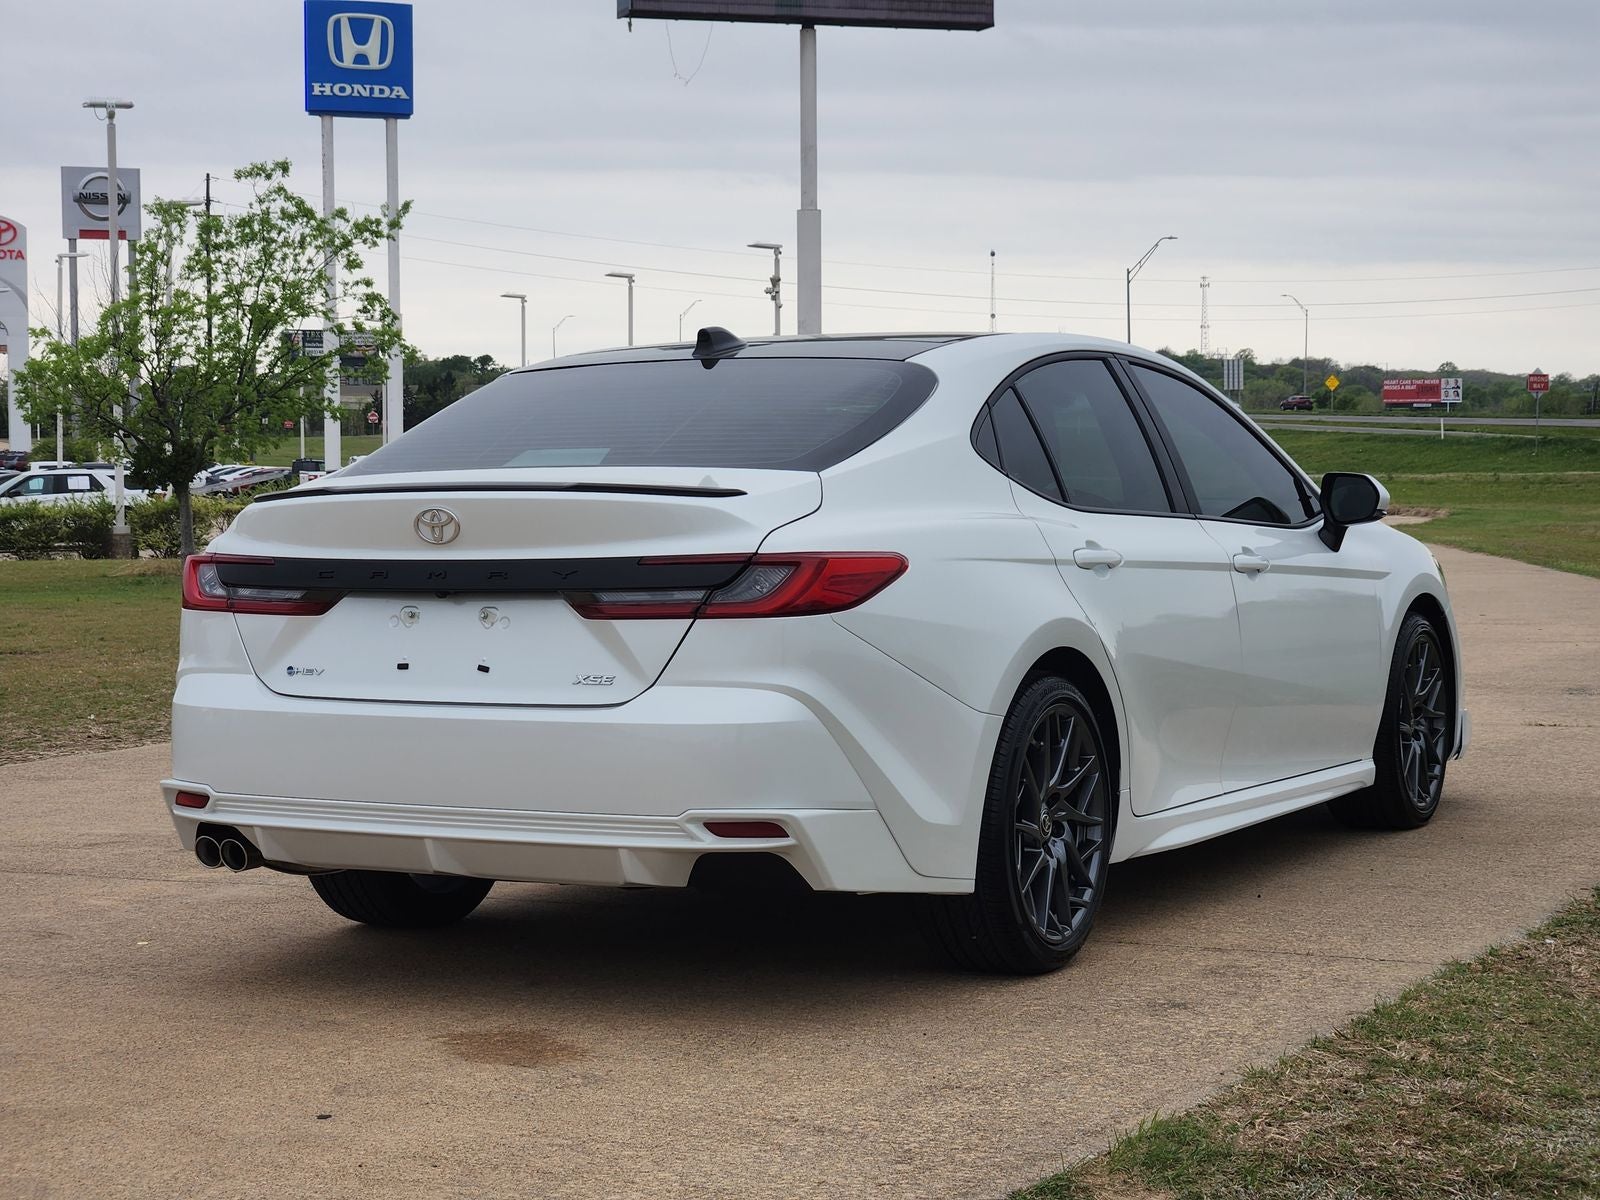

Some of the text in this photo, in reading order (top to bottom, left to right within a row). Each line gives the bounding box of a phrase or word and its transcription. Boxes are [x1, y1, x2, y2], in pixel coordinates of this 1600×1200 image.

[312, 82, 410, 100] HONDA
[79, 192, 126, 201] NISSN
[316, 568, 580, 581] CAMRY
[571, 674, 617, 686] XSE
